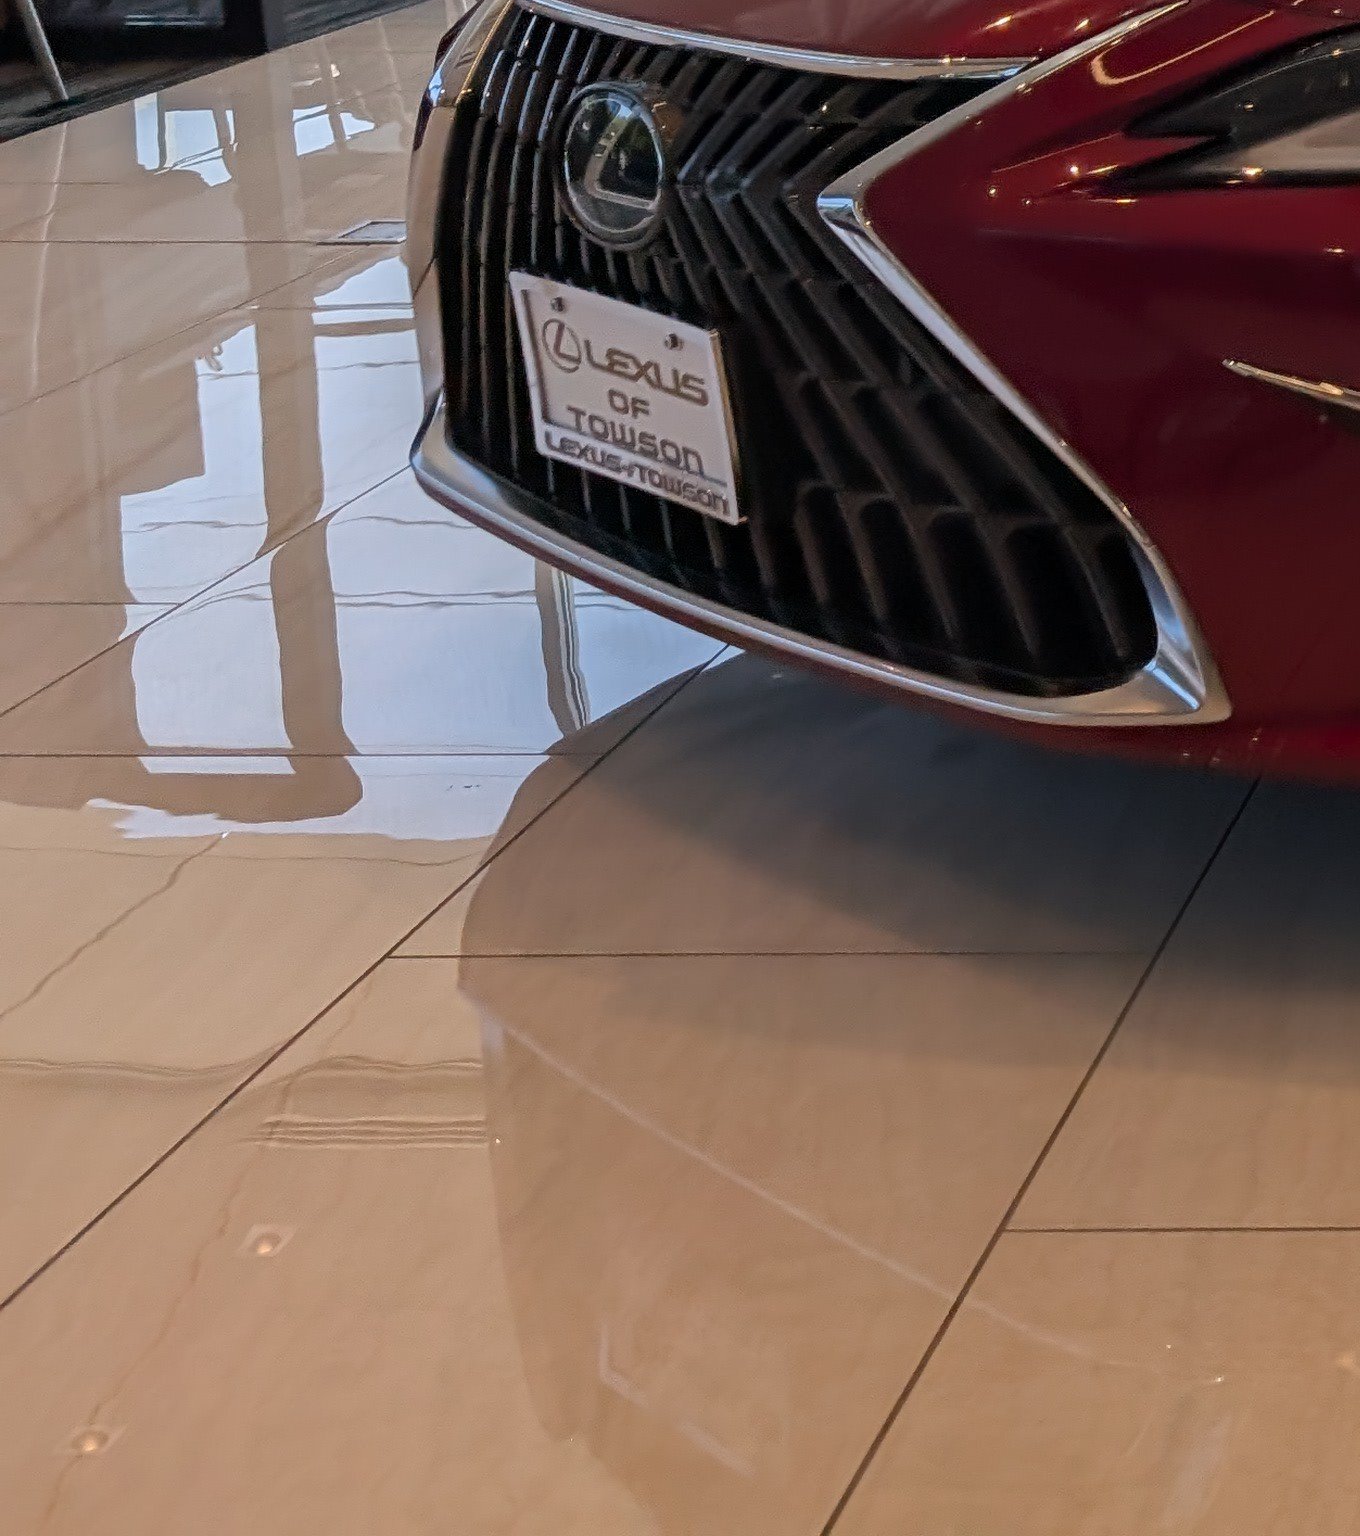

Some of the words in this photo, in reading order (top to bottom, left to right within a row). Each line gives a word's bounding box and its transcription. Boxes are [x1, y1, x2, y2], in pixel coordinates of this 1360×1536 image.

[584, 340, 709, 406] LEXUS
[608, 389, 650, 419] OF
[568, 405, 704, 477] TOWSON
